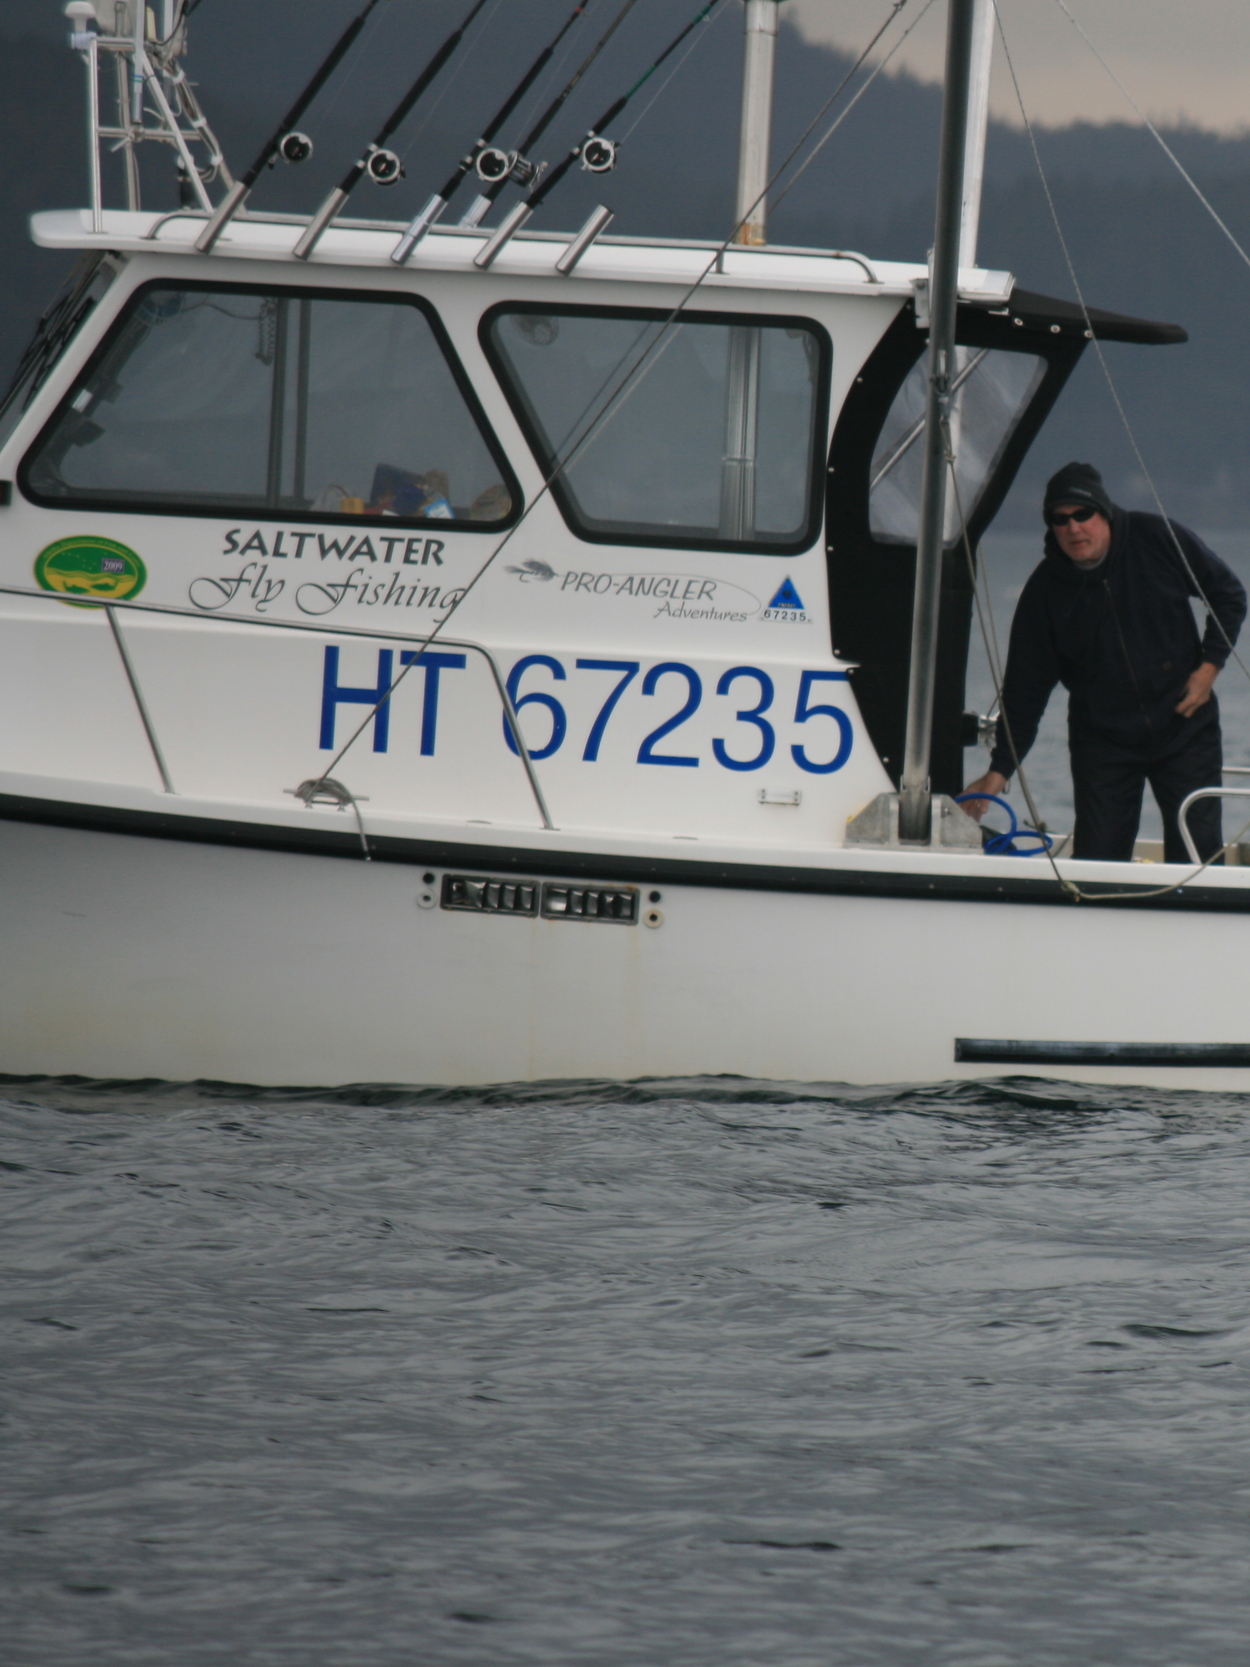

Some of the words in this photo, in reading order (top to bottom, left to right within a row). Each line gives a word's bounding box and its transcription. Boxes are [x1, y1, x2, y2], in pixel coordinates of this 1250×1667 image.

[223, 528, 446, 567] SALTWATER
[103, 560, 123, 572] 2009
[188, 562, 286, 612] Fly
[295, 567, 467, 624] Fishing
[560, 571, 717, 601] PRO-ANGLER
[653, 600, 748, 622] Adventures
[763, 609, 807, 622] 67235
[319, 645, 467, 757] HT
[502, 654, 855, 775] 67235
